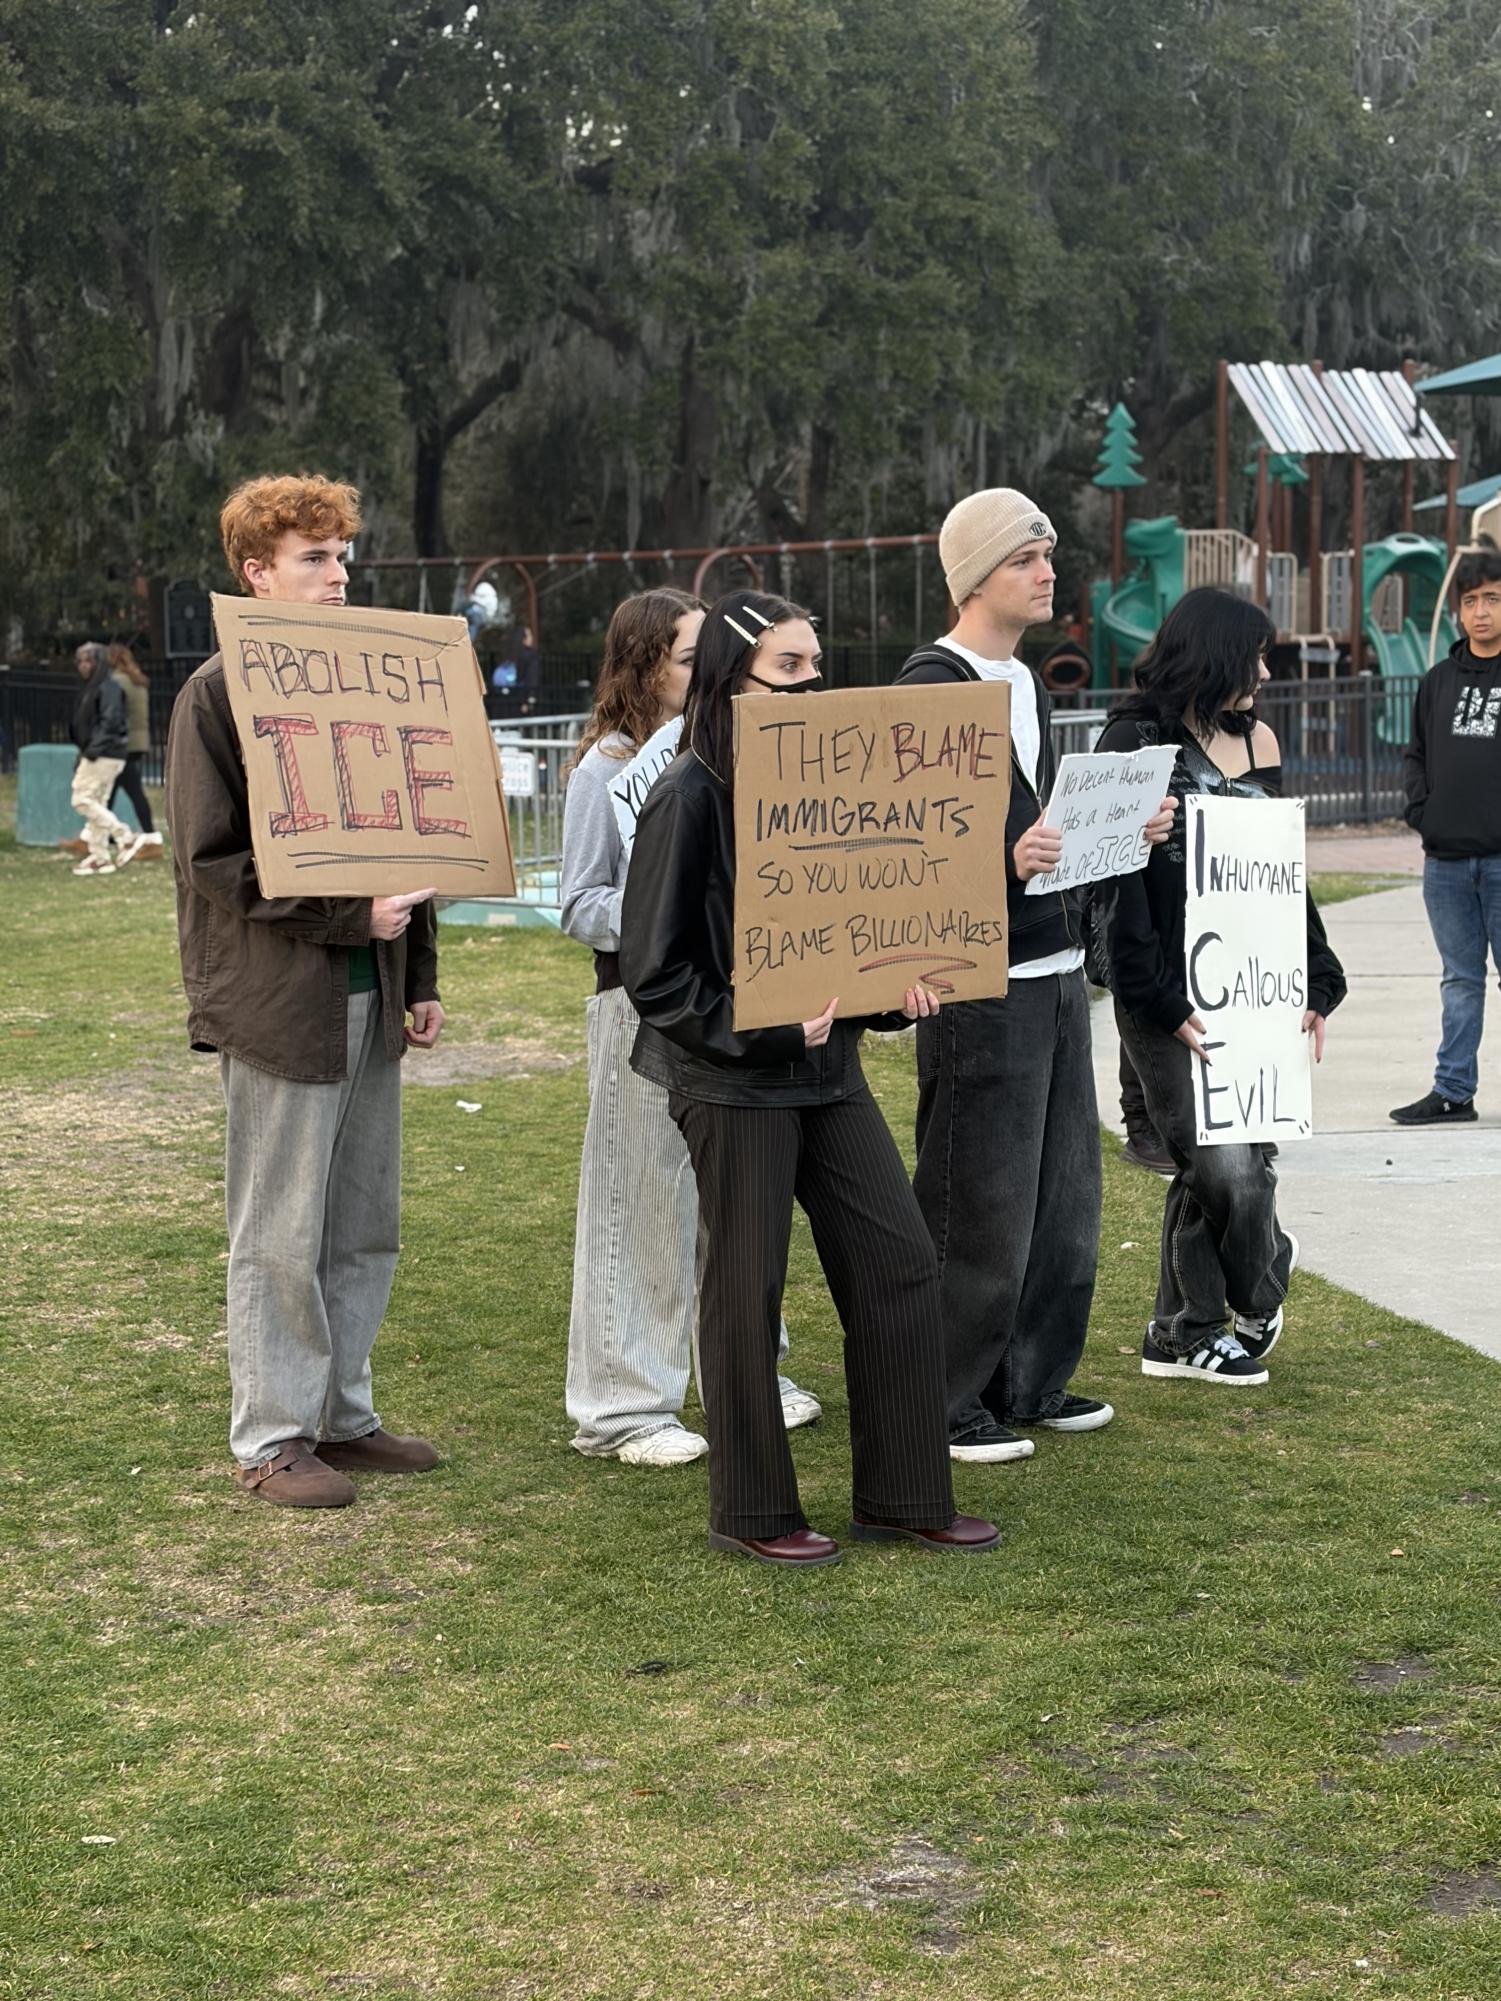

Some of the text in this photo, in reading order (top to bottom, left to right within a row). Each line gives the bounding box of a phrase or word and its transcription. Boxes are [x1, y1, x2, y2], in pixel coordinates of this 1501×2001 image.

[239, 639, 449, 716] ABOLISH
[253, 713, 472, 838] ICE
[759, 721, 1005, 784] THEY BLAME
[1060, 771, 1077, 798] No
[1078, 767, 1115, 793] Decent
[1119, 766, 1155, 785] Human
[756, 796, 975, 842] IMMIGRANTS
[1060, 800, 1140, 834] Has a Heart
[758, 850, 949, 898] SO YOU WON'T
[1091, 825, 1151, 876] ICE
[1195, 809, 1303, 897] INHUMANE
[745, 908, 1003, 983] BLAME BILLIONAIRES
[1201, 1041, 1297, 1131] EVIL
